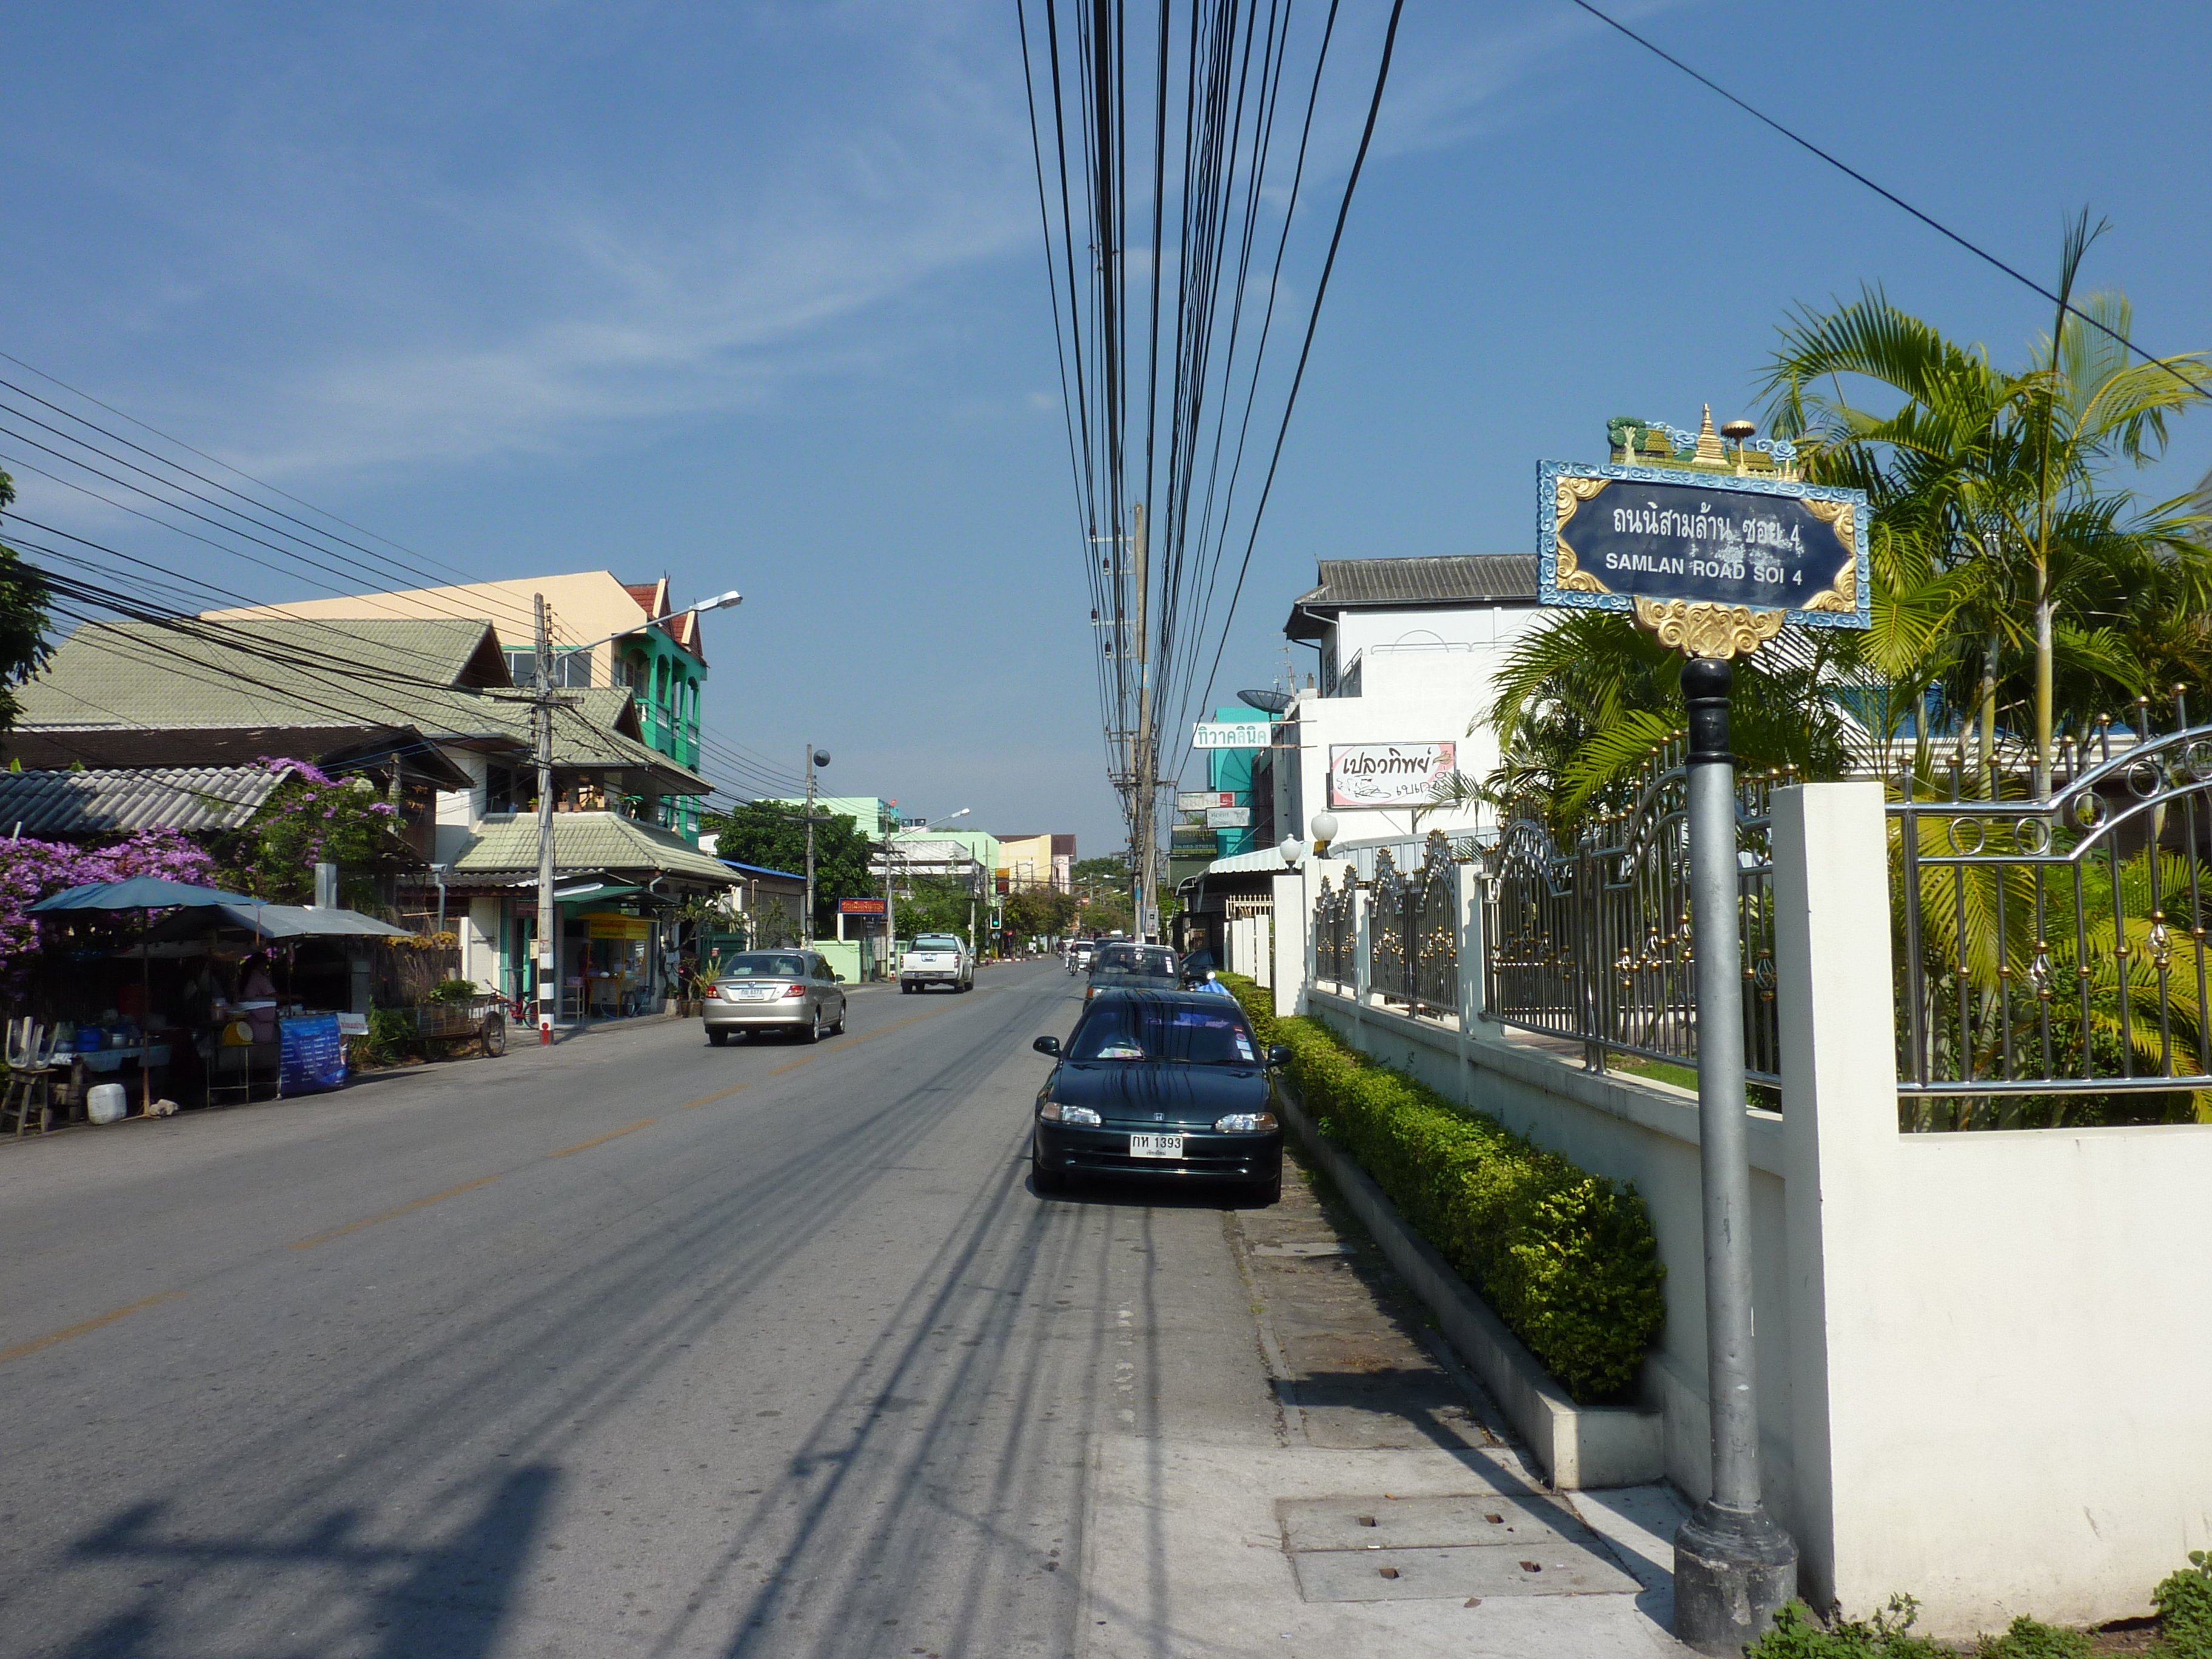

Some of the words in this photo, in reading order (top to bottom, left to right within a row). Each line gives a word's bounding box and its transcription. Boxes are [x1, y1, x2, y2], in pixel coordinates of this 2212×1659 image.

[1742, 518, 1782, 545] ซอย
[1790, 524, 1801, 548] 4
[1605, 552, 1684, 575] SAMLAN
[1692, 560, 1746, 580] ROAD
[1753, 566, 1785, 584] SOI
[1792, 569, 1803, 586] 4
[1198, 725, 1267, 745] ทิวาคลินิค
[1342, 747, 1432, 775] เปลวทิพย์
[1155, 1136, 1181, 1148] 1393
